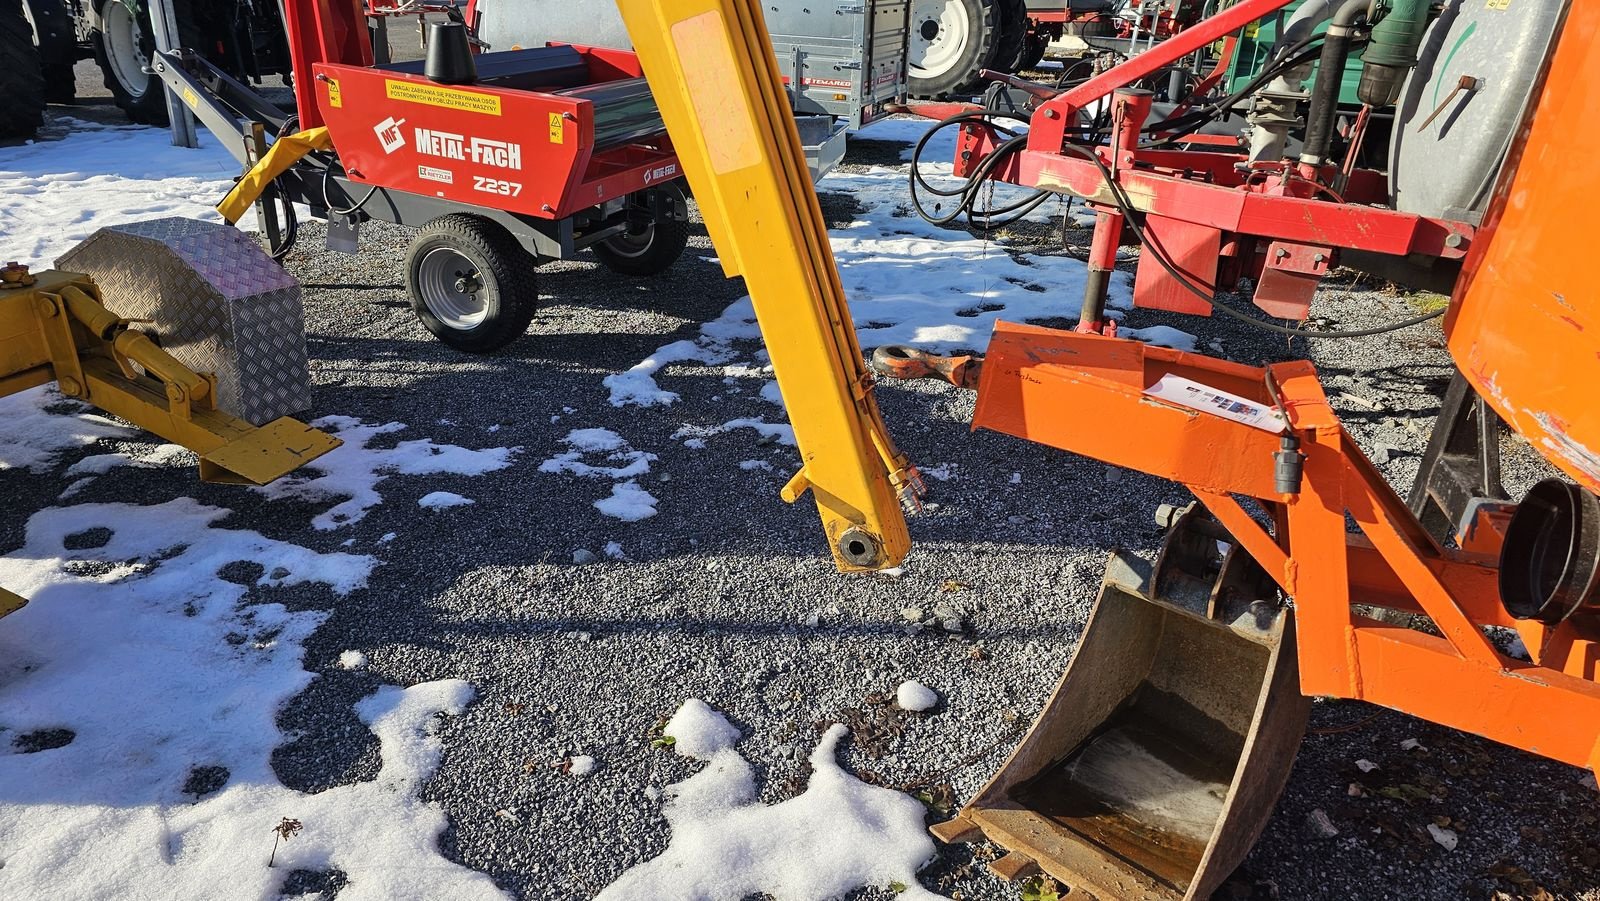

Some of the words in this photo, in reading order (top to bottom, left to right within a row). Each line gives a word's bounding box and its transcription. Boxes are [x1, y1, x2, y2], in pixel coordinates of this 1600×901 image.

[812, 79, 851, 87] TEMARED
[390, 90, 427, 101] POSTRONNYCH
[473, 104, 497, 112] MASZYNY
[410, 87, 436, 96] ZABRANIA
[445, 92, 481, 103] PRZEBYWANIA
[380, 124, 397, 146] MF
[427, 171, 452, 180] RIETZLER
[473, 175, 523, 197] Z237
